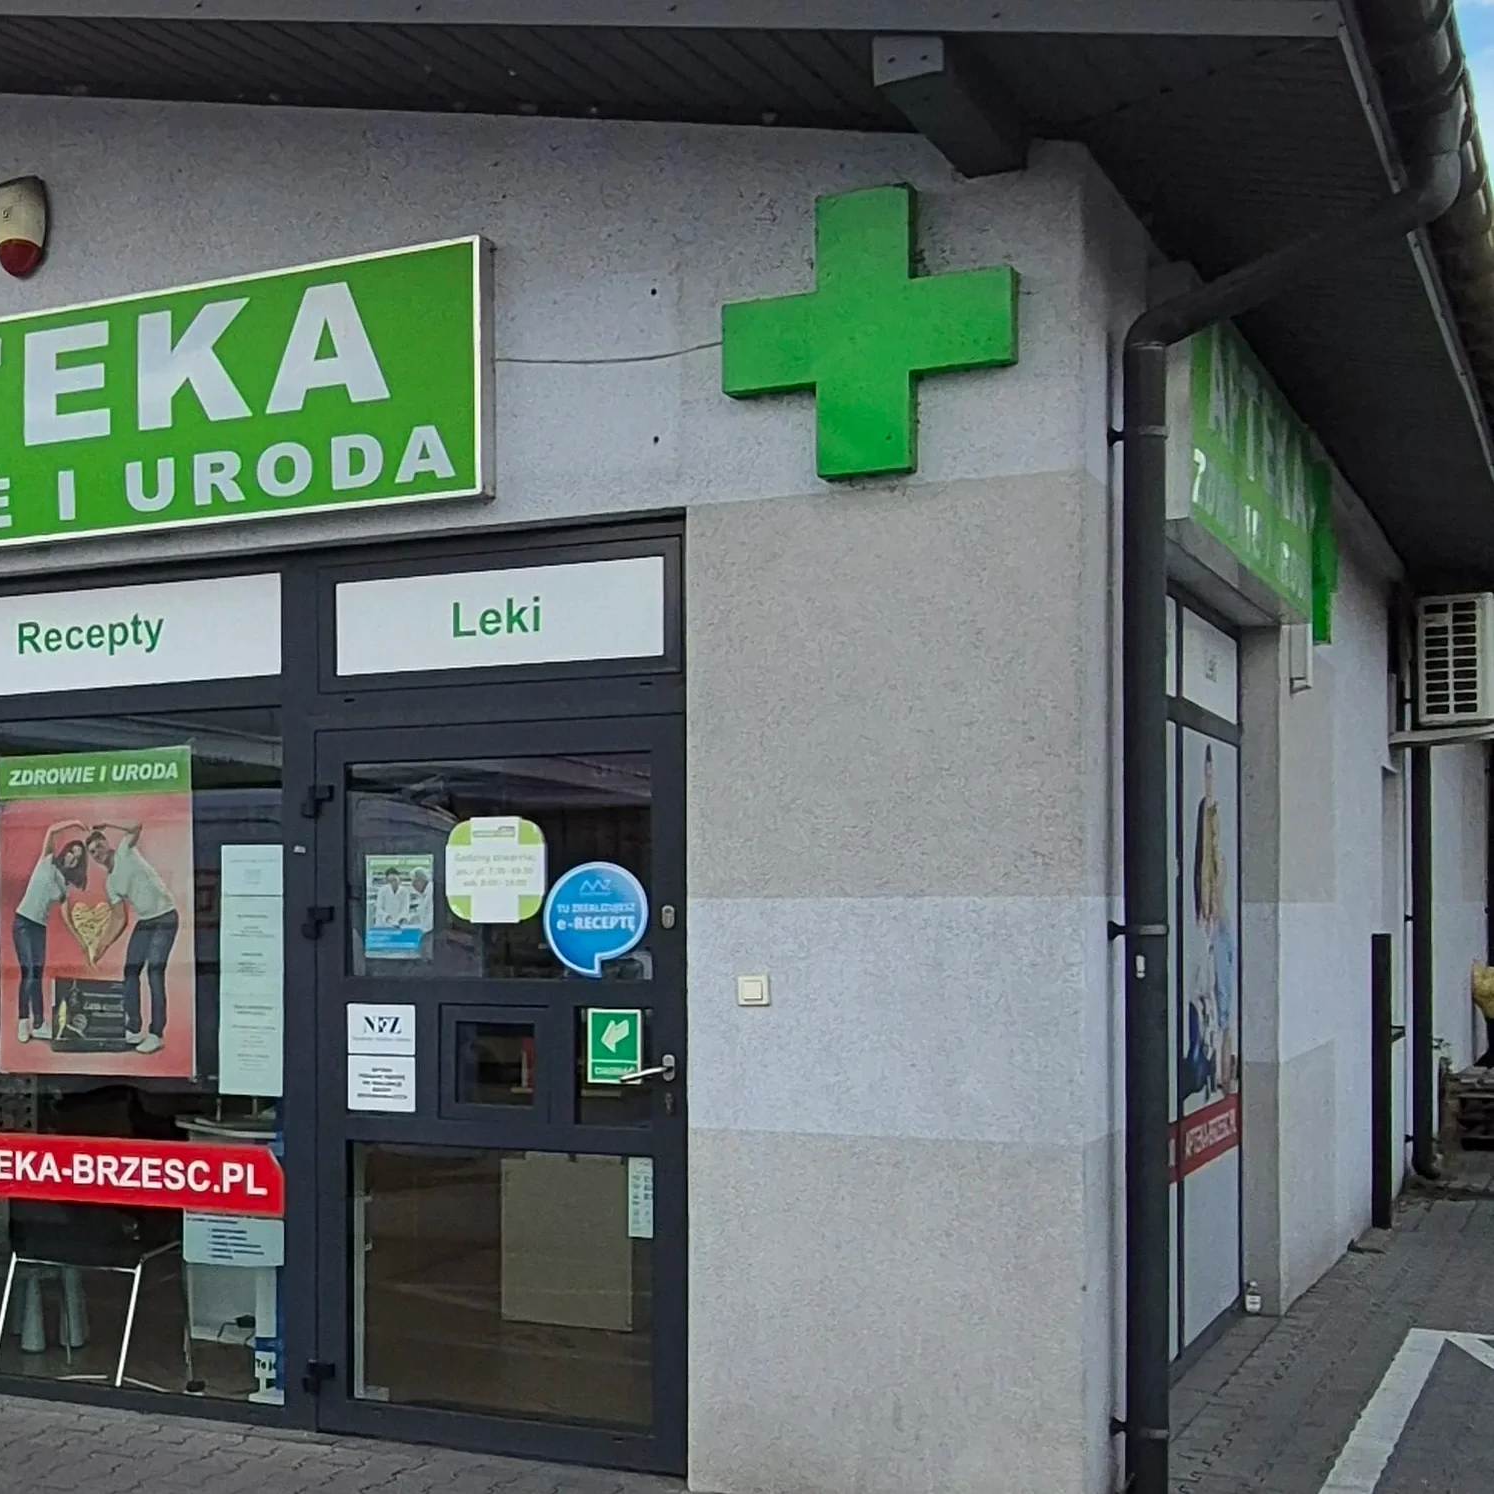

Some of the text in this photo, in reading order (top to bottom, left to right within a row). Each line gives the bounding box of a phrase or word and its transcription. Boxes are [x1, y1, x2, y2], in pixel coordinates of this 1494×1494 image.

[58, 471, 76, 521] I
[125, 425, 456, 513] URODA
[452, 596, 540, 637] Leki
[18, 614, 163, 656] Recepty
[8, 762, 179, 786] ZDROWIE I URODA
[556, 915, 635, 933] e-RECEPTĘ
[364, 1016, 401, 1034] NFZ
